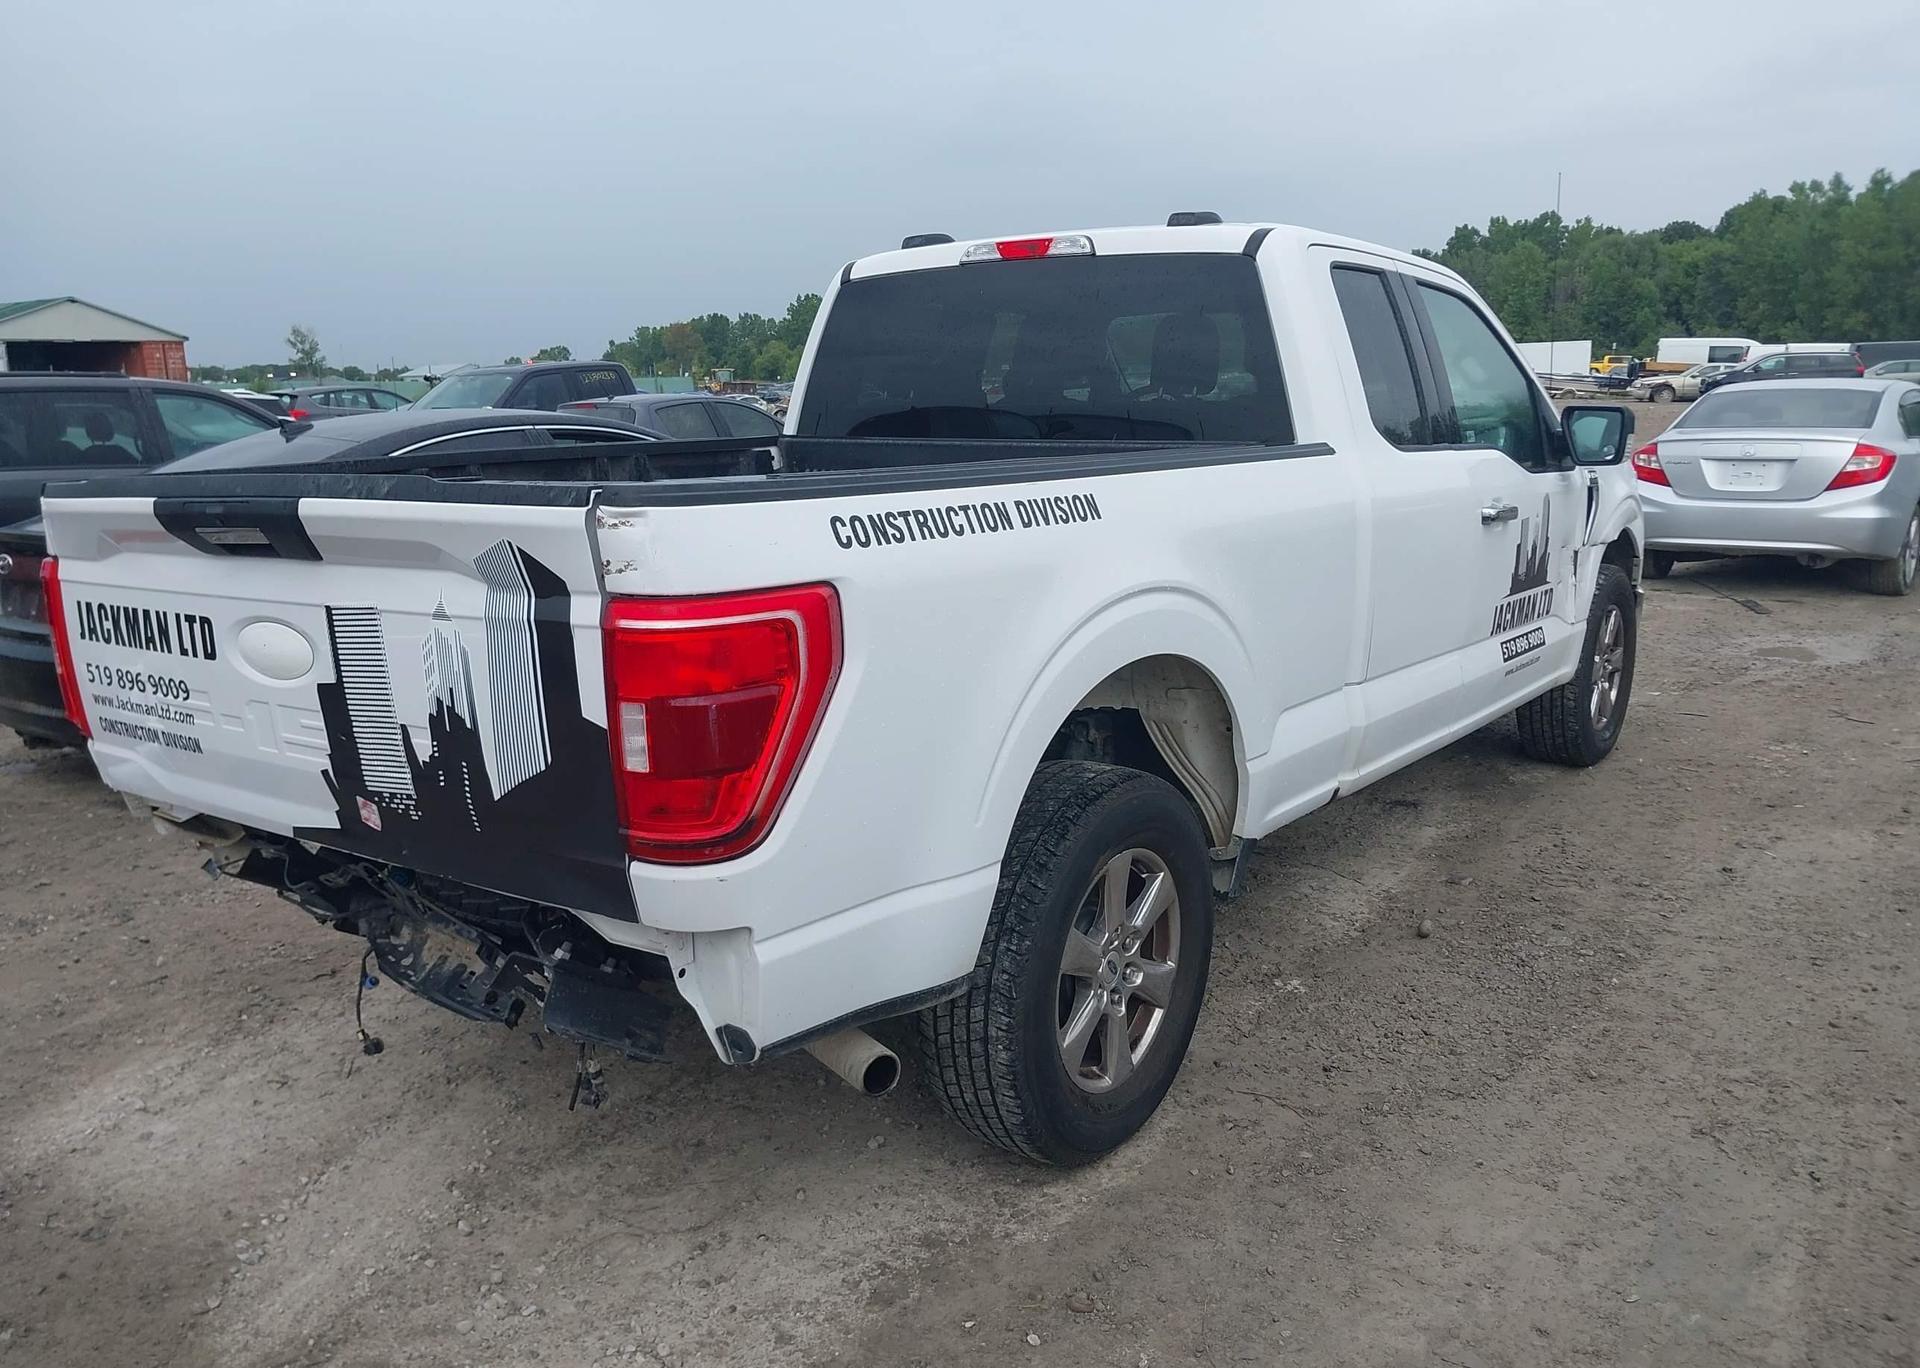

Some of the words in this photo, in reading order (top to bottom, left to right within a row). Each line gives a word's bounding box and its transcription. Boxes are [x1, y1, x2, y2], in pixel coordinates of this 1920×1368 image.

[830, 501, 1014, 550] CONSTRUCTION
[1013, 493, 1102, 529] DIVISION
[76, 600, 173, 655] JACKMAN
[175, 612, 217, 661] LTD
[1490, 592, 1539, 637] JACKMAN
[1537, 588, 1554, 619] LTD
[1502, 640, 1516, 659] 519
[1515, 635, 1529, 653] 896
[1527, 629, 1544, 648] 9009
[86, 662, 114, 687] 519
[116, 668, 146, 693] 896
[147, 674, 190, 701] 9009
[92, 694, 195, 726] www.JackmanLtd.com
[99, 716, 162, 745] CONSTRUCTION
[161, 730, 204, 754] DIVISION
